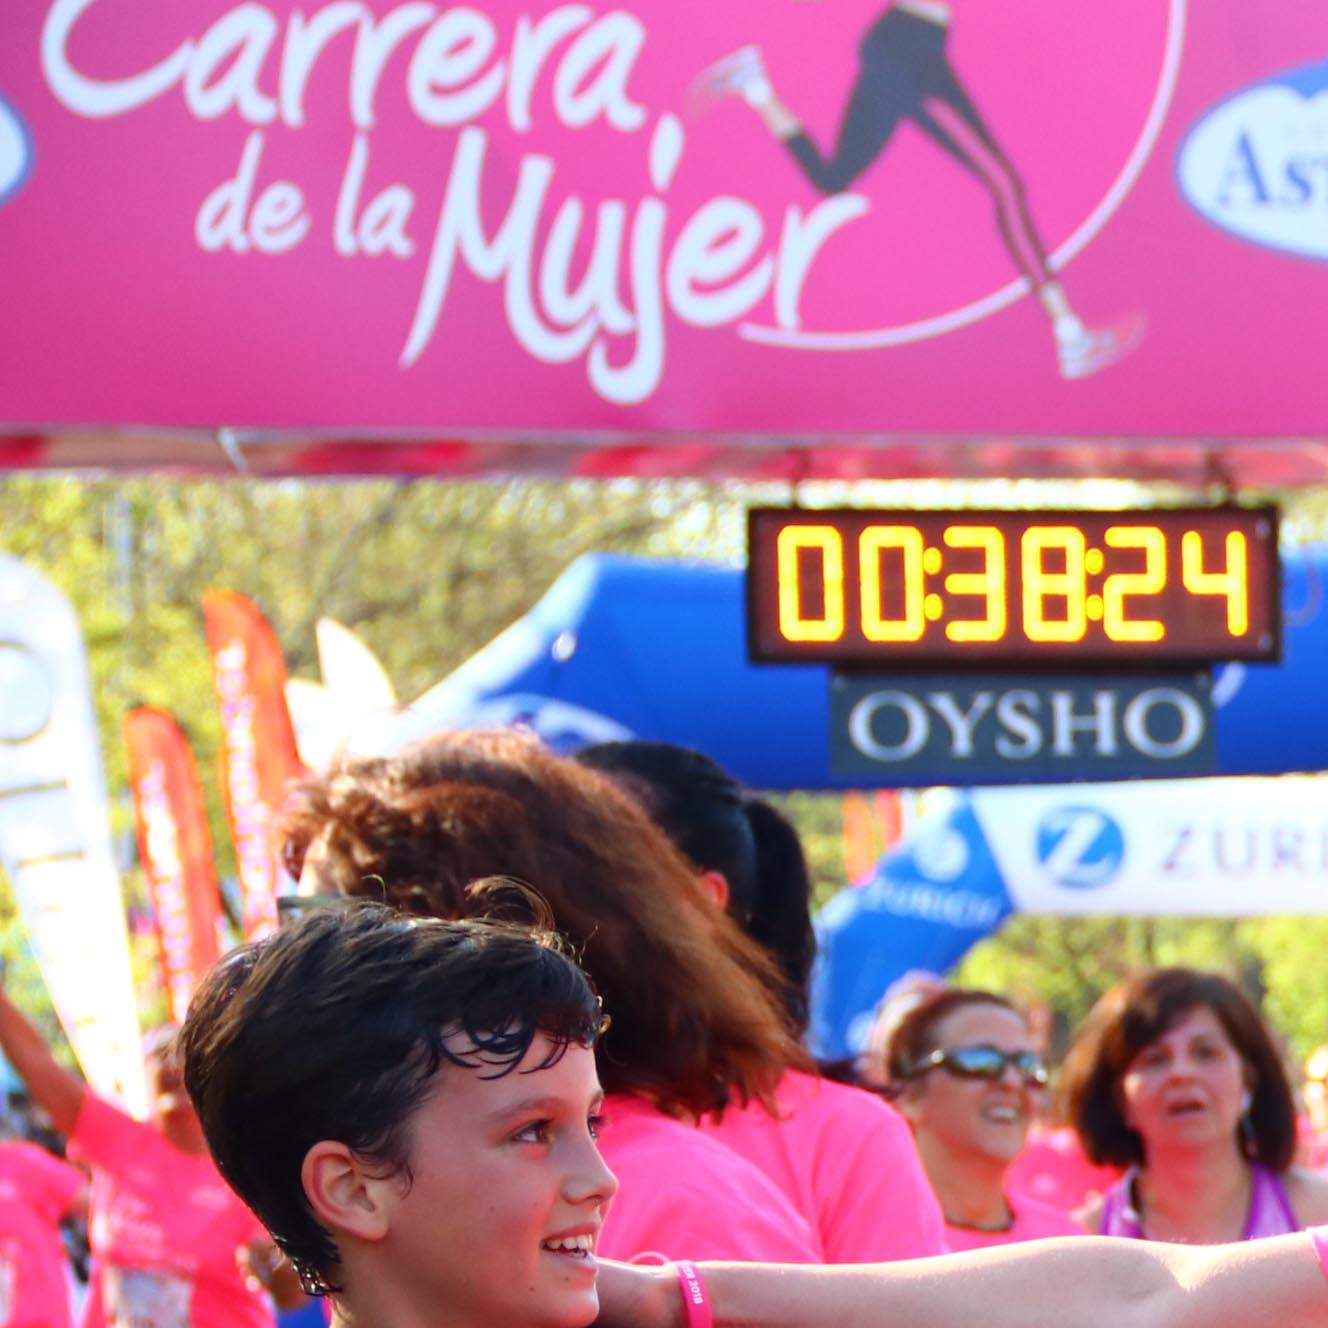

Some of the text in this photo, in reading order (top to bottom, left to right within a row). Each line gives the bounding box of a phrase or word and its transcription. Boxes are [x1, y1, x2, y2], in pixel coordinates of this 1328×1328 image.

[40, 0, 648, 134] Carrera
[195, 128, 415, 256] de la
[398, 115, 872, 405] Mujer
[777, 524, 1248, 642] 00:38:24
[849, 687, 1204, 762] OYSHO
